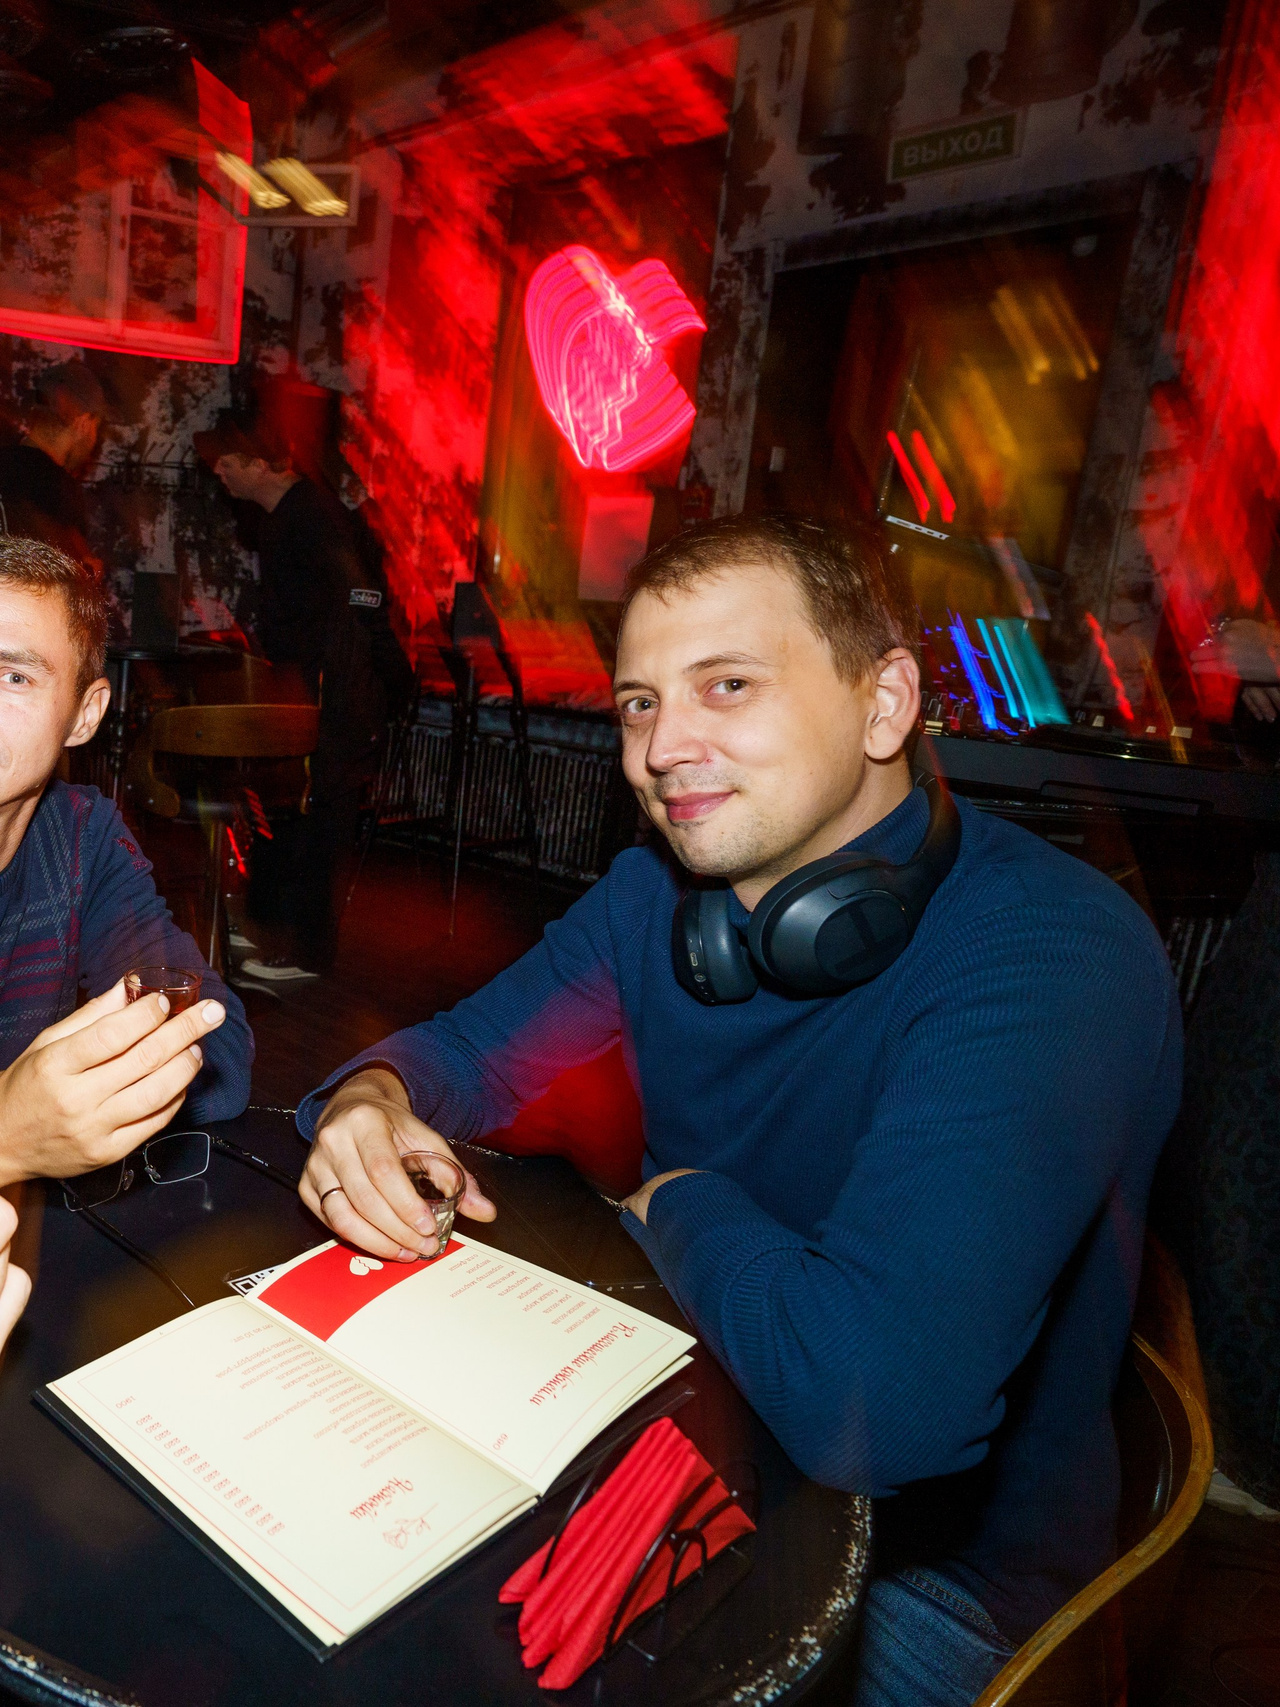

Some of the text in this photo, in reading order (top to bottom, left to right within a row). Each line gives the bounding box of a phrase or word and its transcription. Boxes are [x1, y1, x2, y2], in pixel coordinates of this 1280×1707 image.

[904, 126, 1003, 167] ВЫХОД
[448, 1280, 477, 1298] мартини
[497, 1276, 530, 1296] маргарита
[528, 1322, 637, 1406] Классические коктейли
[114, 1396, 136, 1408] 1900
[134, 1415, 153, 1425] 220
[143, 1422, 162, 1433] 220
[242, 1414, 284, 1439] смородина
[153, 1430, 171, 1440] 220
[491, 1433, 508, 1449] 690
[162, 1437, 181, 1448] 220
[172, 1445, 191, 1457] 220
[181, 1453, 201, 1465] 220
[191, 1461, 211, 1473] 220
[201, 1470, 221, 1482] 220
[212, 1478, 232, 1491] 220
[222, 1487, 242, 1499] 220
[350, 1477, 411, 1521] Настойки
[233, 1496, 252, 1508] 220
[243, 1504, 263, 1517] 220
[254, 1513, 274, 1526] 220
[265, 1522, 285, 1536] 220
